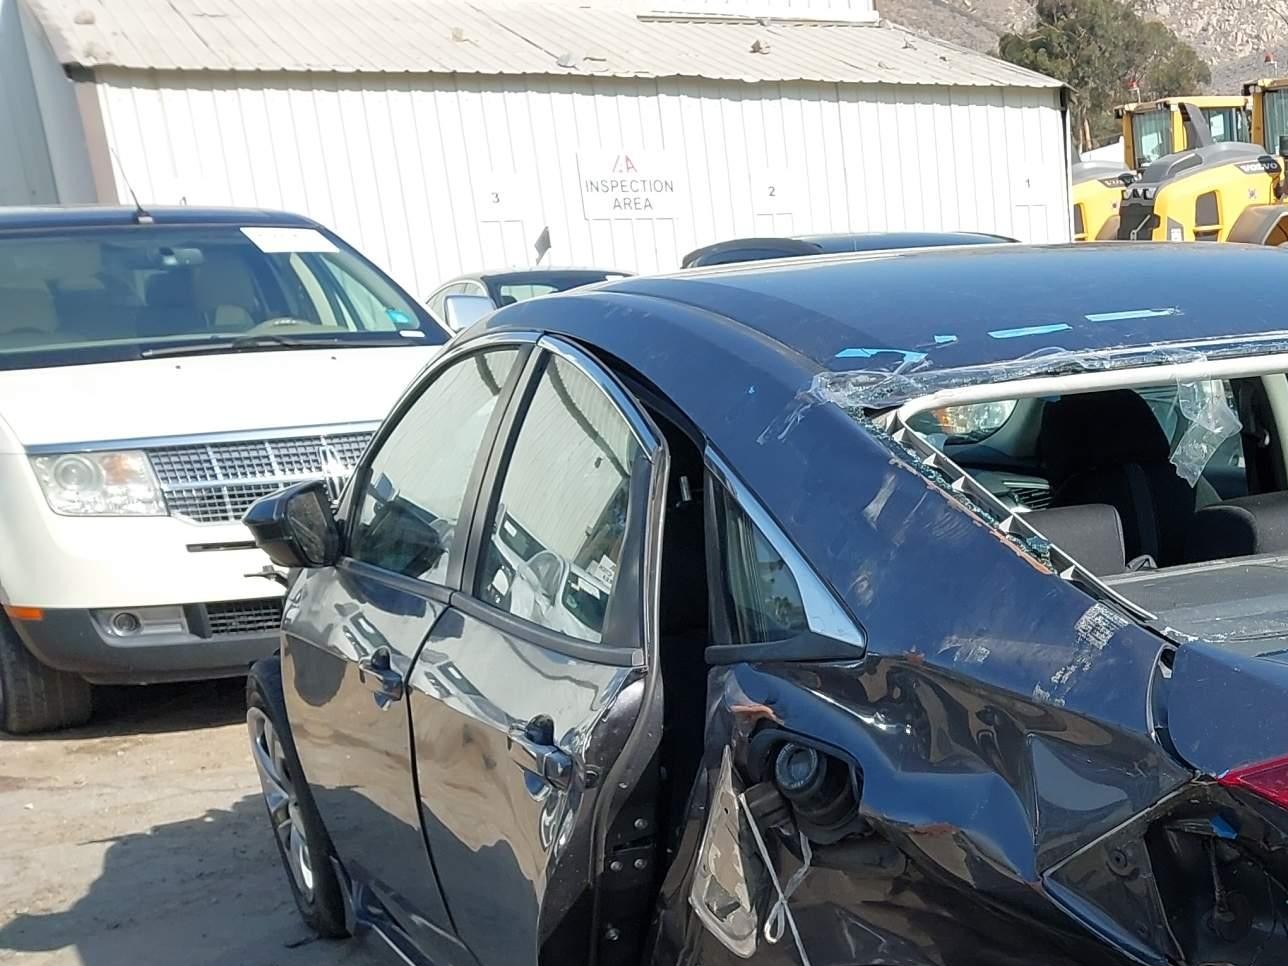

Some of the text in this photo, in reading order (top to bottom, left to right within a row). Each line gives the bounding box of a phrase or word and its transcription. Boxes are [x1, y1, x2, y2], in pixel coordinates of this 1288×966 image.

[585, 179, 674, 193] INSPECTION
[1024, 177, 1031, 189] 1
[490, 191, 501, 204] 3
[767, 185, 777, 197] 2
[612, 197, 654, 211] AREA
